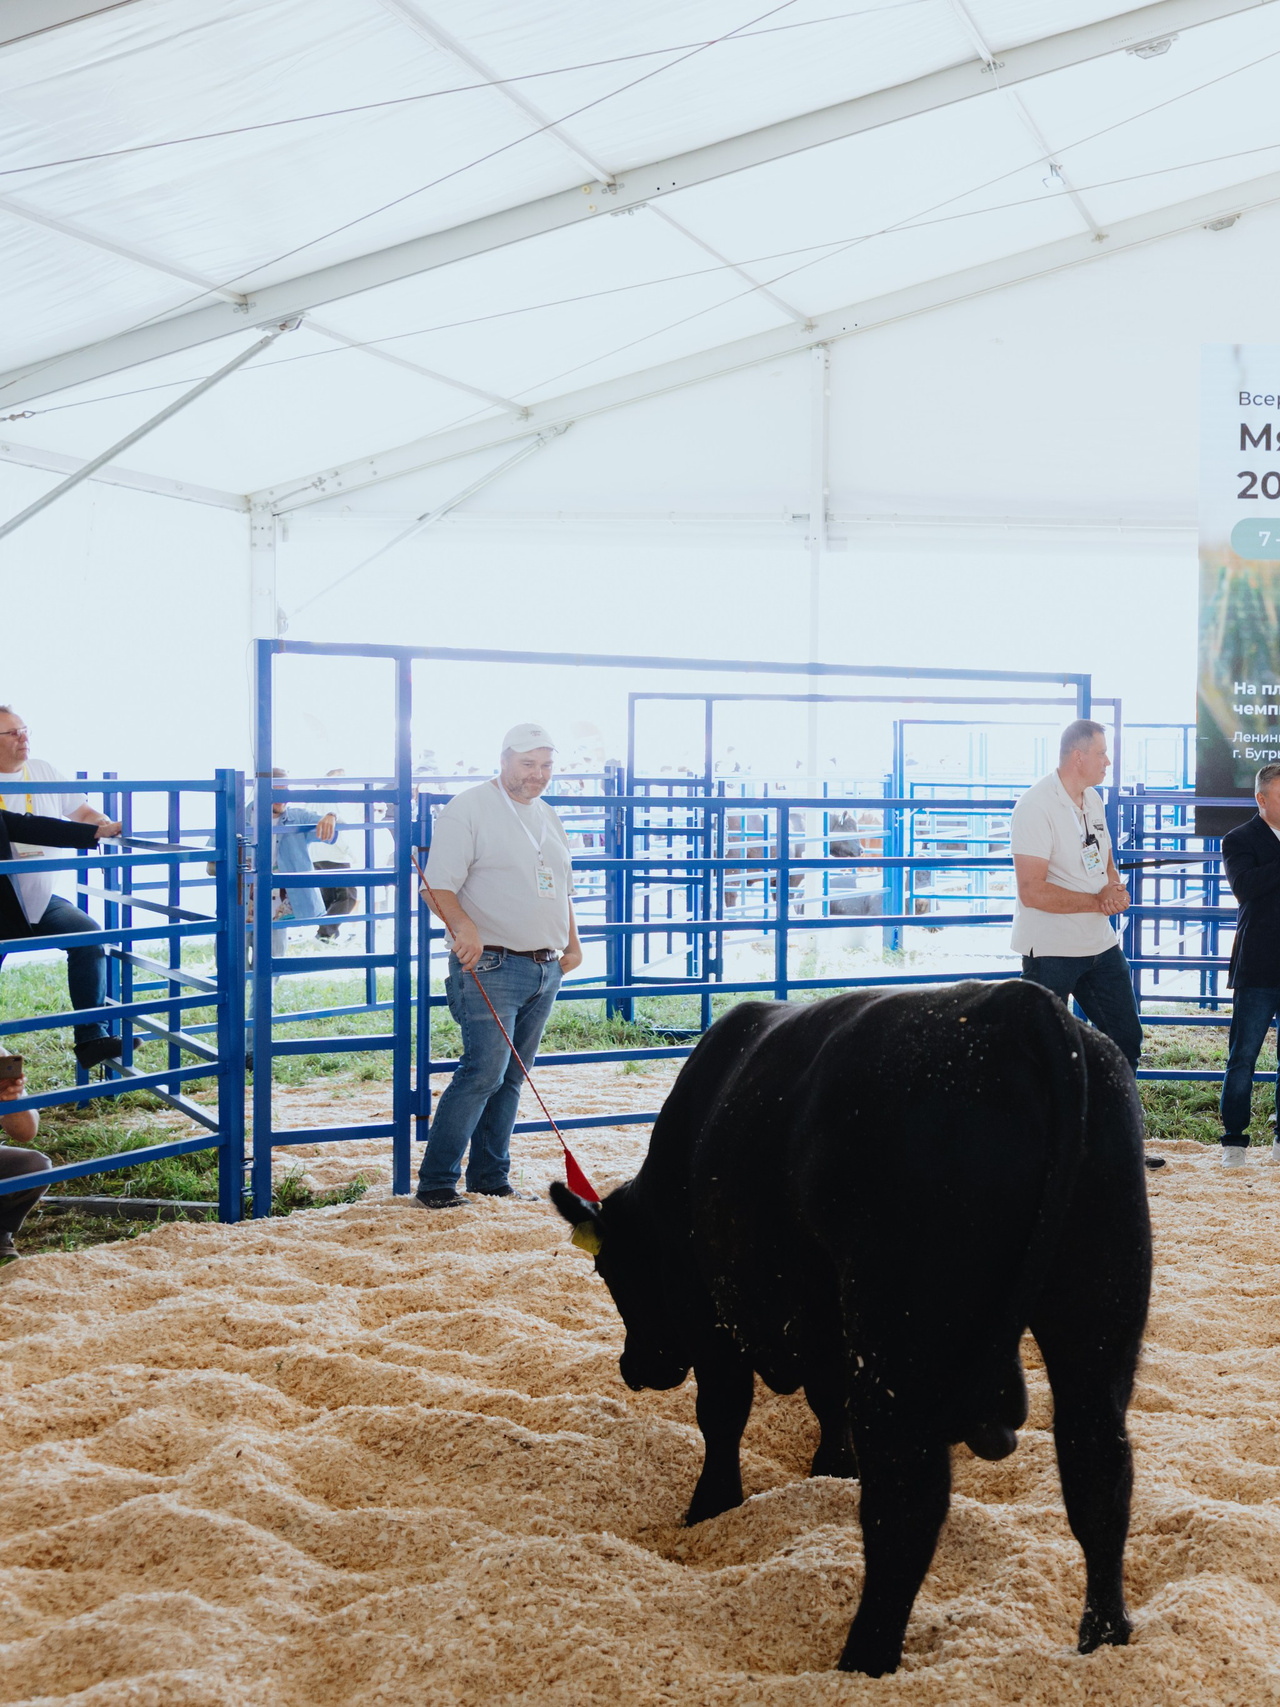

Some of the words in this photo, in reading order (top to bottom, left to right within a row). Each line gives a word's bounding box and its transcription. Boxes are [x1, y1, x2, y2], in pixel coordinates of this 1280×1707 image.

[1258, 531, 1271, 547] 7
[1233, 682, 1256, 695] На
[1232, 749, 1242, 759] г.
